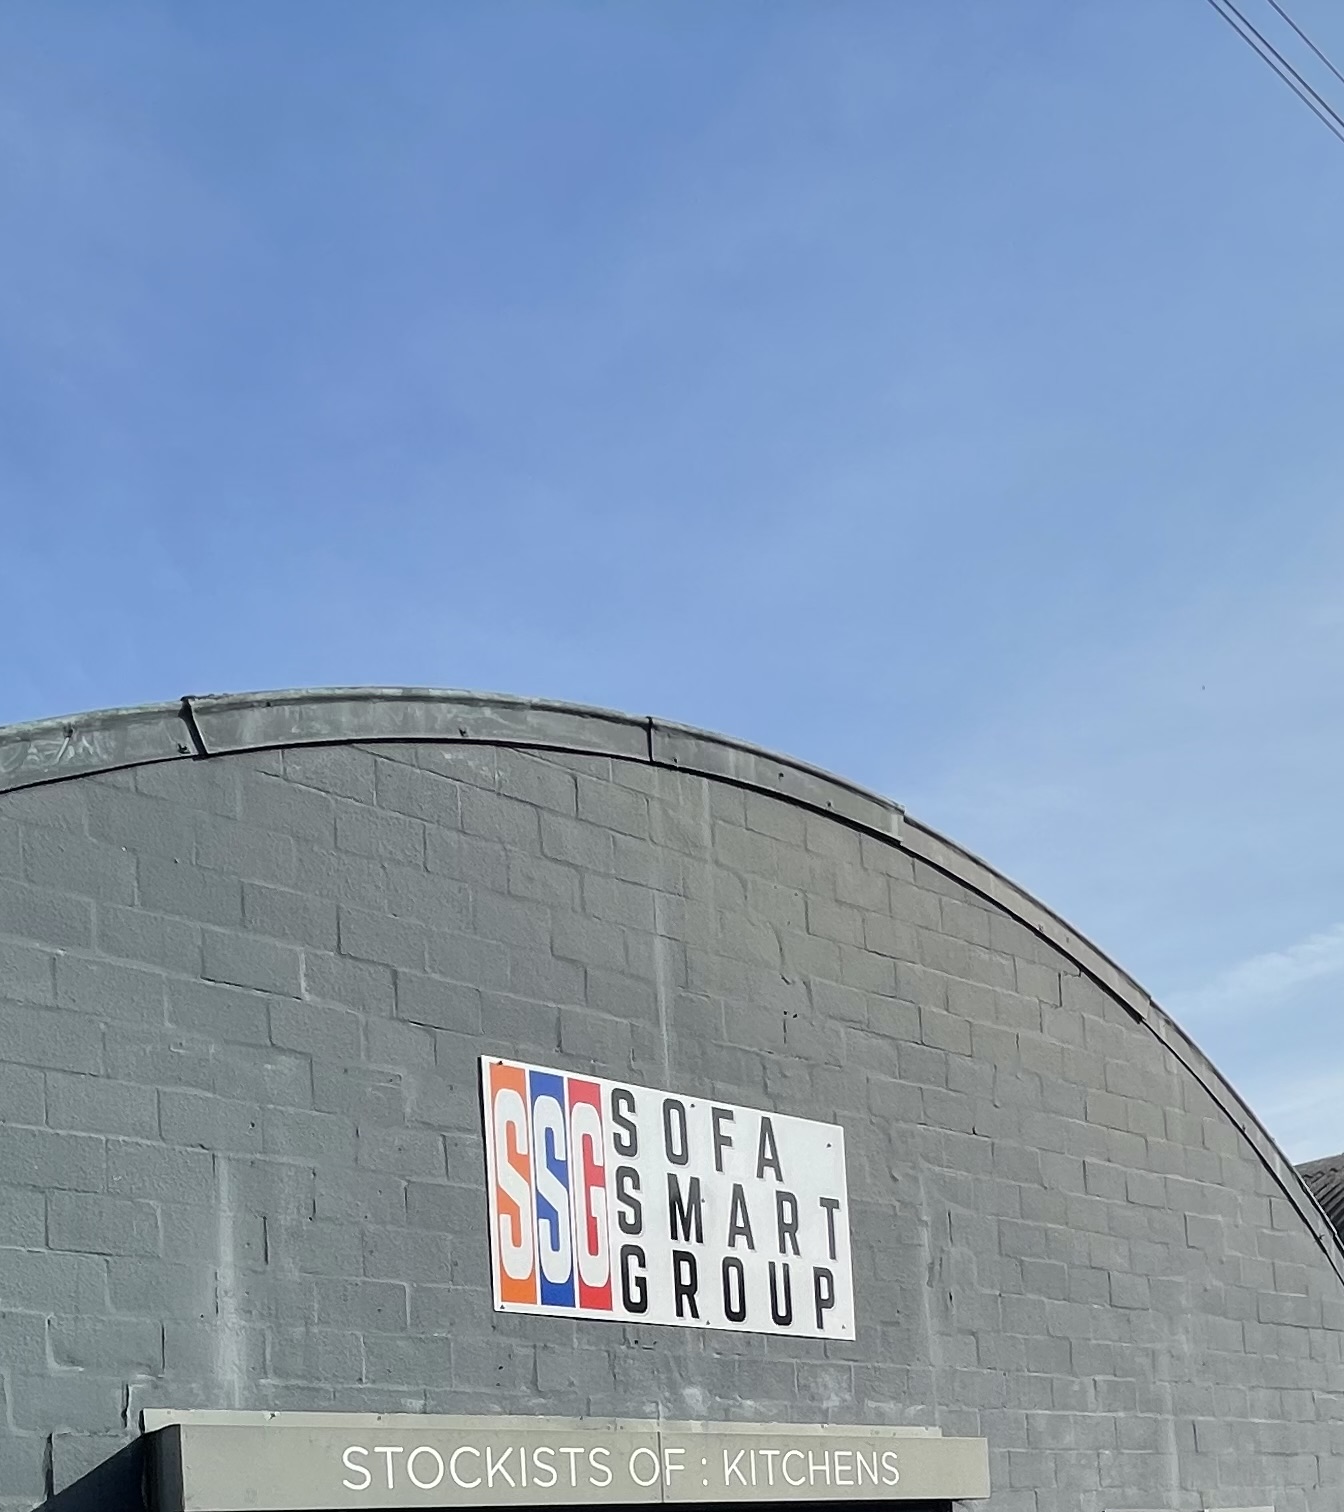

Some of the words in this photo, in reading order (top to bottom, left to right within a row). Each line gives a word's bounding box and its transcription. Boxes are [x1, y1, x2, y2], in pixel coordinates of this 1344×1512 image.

[611, 1088, 784, 1183] SOFA
[494, 1088, 612, 1288] SSG
[615, 1166, 840, 1260] SMART
[620, 1244, 835, 1330] GROUP
[341, 1445, 614, 1491] STOCKISTS
[628, 1446, 687, 1488] OF
[722, 1449, 901, 1487] KITCHENS
